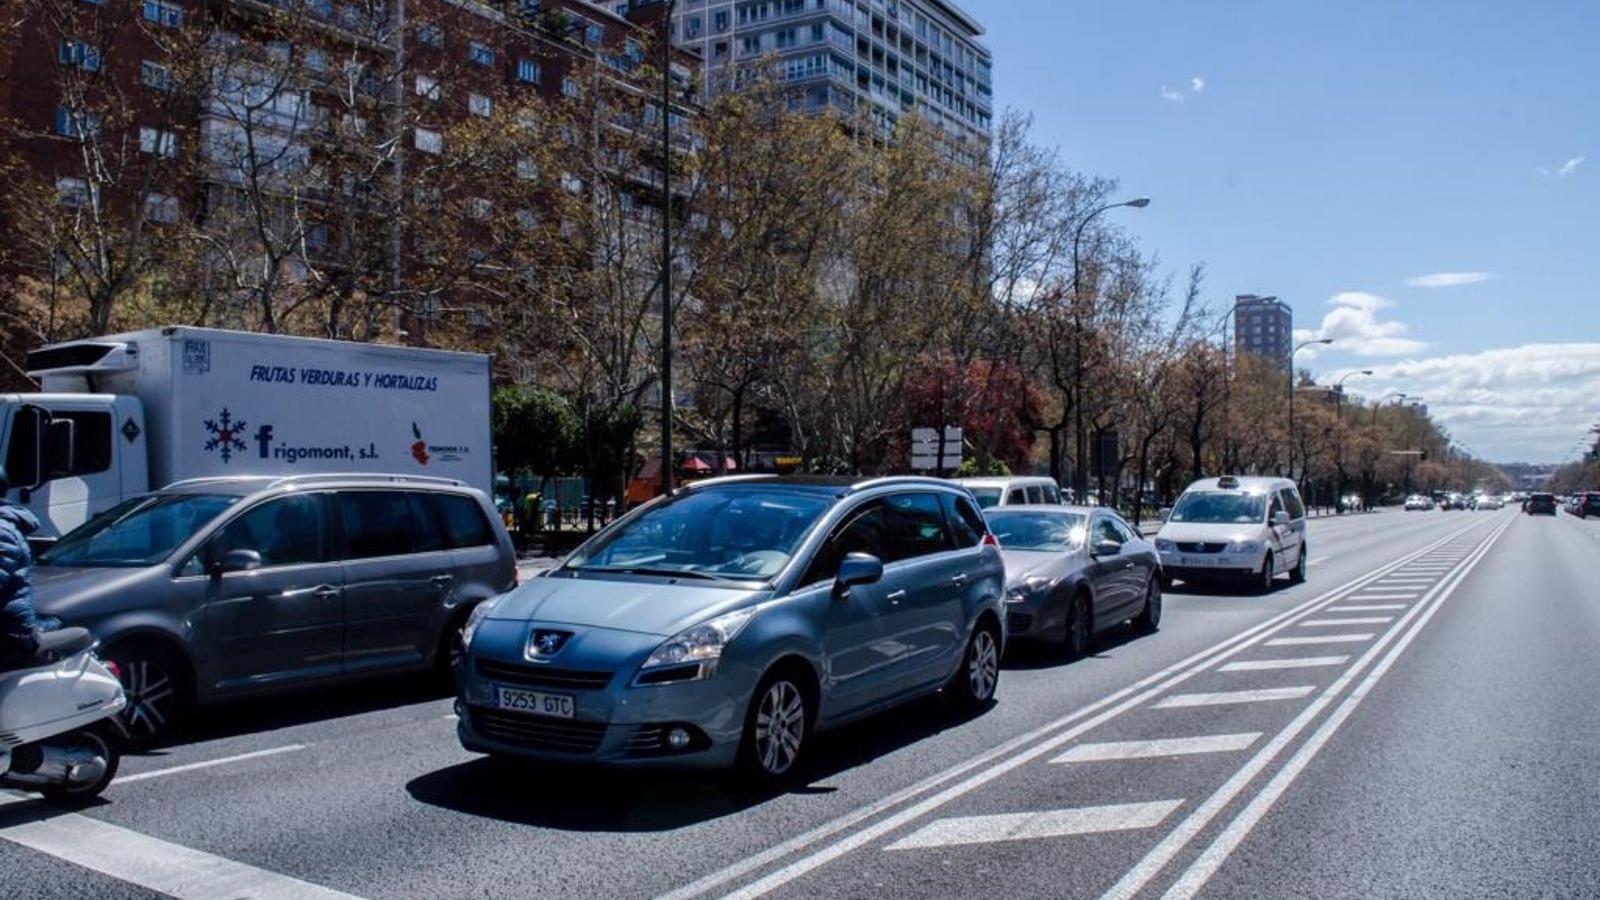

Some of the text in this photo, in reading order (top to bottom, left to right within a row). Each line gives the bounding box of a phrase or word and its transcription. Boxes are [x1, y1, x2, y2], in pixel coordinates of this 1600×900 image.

[250, 365, 438, 391] FRUTAS VERDURAS Y HORTALIZAS
[360, 442, 378, 459] s.l.
[502, 690, 571, 715] 9253 GTC
